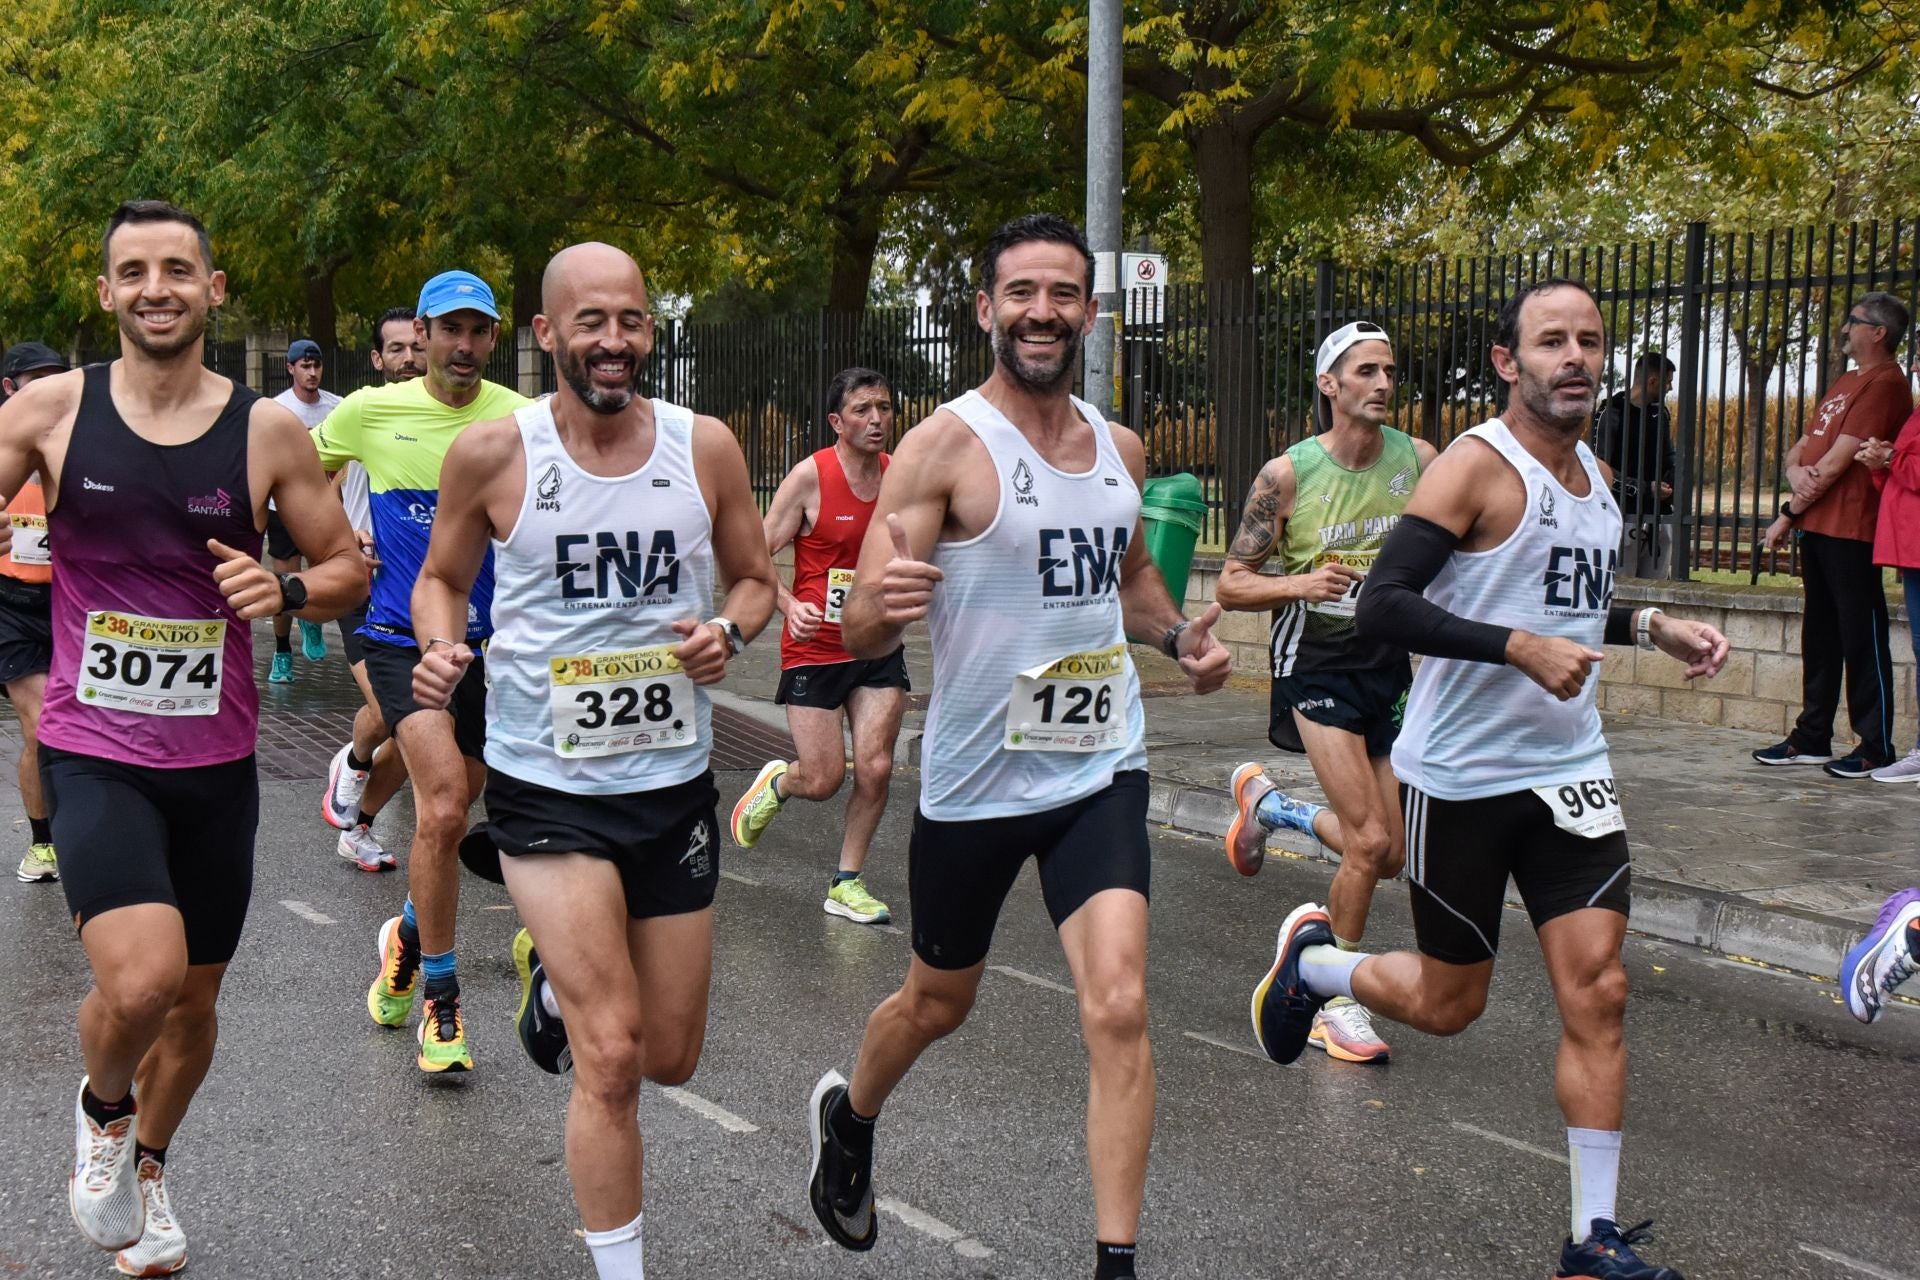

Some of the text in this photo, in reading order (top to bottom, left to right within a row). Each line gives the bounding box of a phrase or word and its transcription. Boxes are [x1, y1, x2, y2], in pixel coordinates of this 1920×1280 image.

[188, 504, 231, 517] SANTA FE
[1318, 521, 1356, 545] TEAM
[556, 530, 680, 599] ENA
[1038, 527, 1128, 597] ENA
[840, 573, 852, 582] 38
[564, 601, 637, 610] ENTRENAMIENTO
[646, 598, 673, 606] SALUD
[1544, 609, 1599, 619] ENTRENAMIENTO
[107, 616, 129, 635] 38
[128, 625, 199, 643] FONDO
[133, 620, 159, 630] GRAN
[161, 623, 194, 631] PREMIO
[87, 642, 218, 690] 3074
[593, 657, 662, 677] FONDO
[596, 655, 621, 664] GRAN
[623, 651, 655, 661] PREMIO
[570, 659, 592, 677] 38
[575, 682, 673, 730] 328
[1032, 684, 1112, 724] 126
[742, 787, 768, 815] HOKA
[1558, 778, 1619, 819] 969
